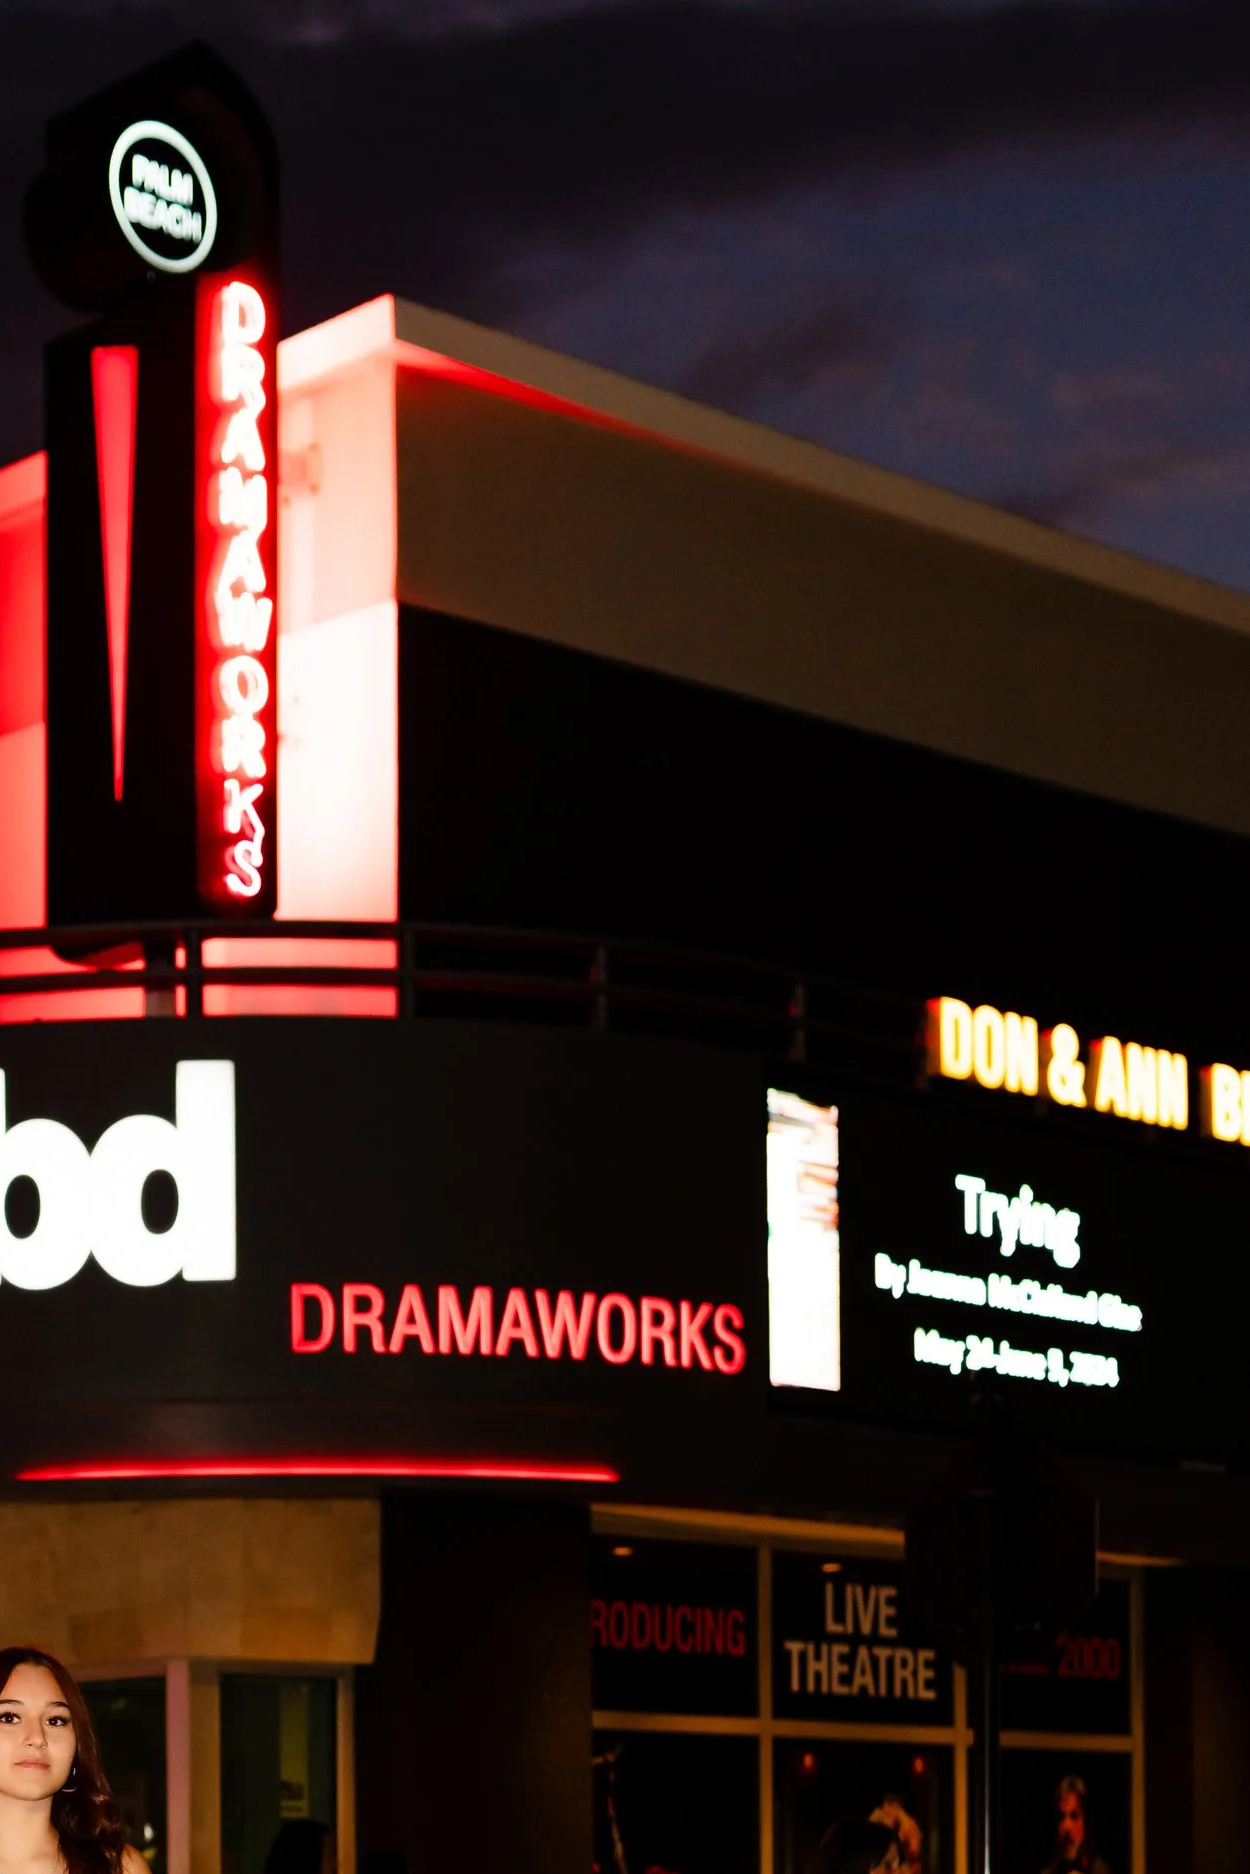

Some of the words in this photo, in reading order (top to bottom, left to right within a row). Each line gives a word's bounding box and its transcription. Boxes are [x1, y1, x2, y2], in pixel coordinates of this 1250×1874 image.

[132, 154, 193, 206] PALM
[124, 186, 202, 243] BEACH
[217, 279, 274, 898] DRAMAWORKS
[937, 996, 1040, 1096] DON
[1046, 1023, 1088, 1107] &
[1093, 1036, 1189, 1130] ANN
[1209, 1062, 1250, 1147] B
[955, 1174, 1081, 1268] Trying
[875, 1253, 906, 1298] By
[289, 1282, 746, 1375] DRAMAWORKS
[823, 1581, 899, 1639] LIVE
[783, 1640, 937, 1701] THEATRE
[1056, 1634, 1123, 1682] 2000
